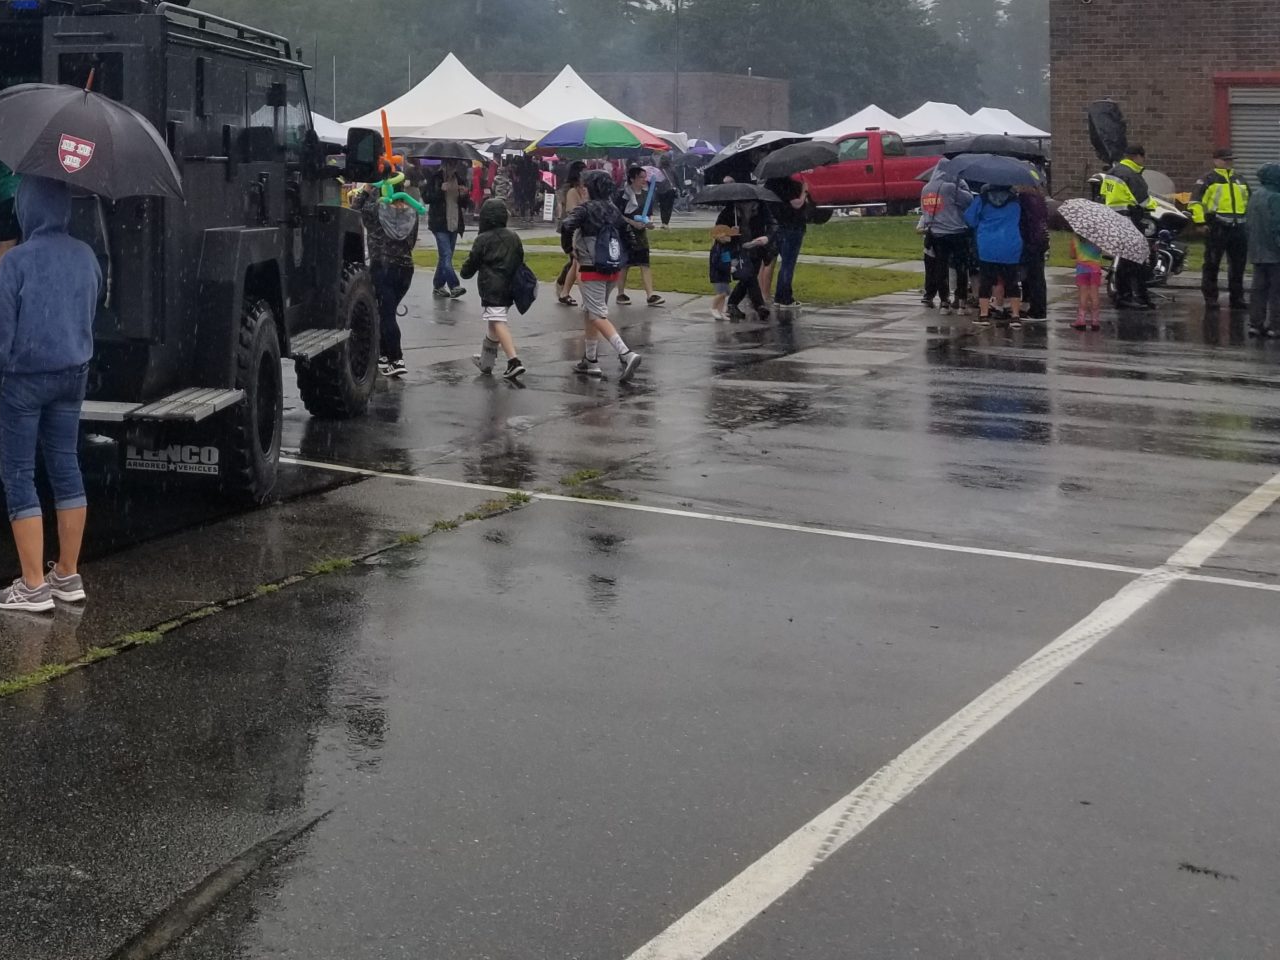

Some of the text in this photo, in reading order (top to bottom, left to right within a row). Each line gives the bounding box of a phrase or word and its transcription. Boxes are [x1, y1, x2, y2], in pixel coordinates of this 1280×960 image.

[126, 444, 219, 465] LENCO
[127, 461, 218, 473] ARMORED VEHICLES
